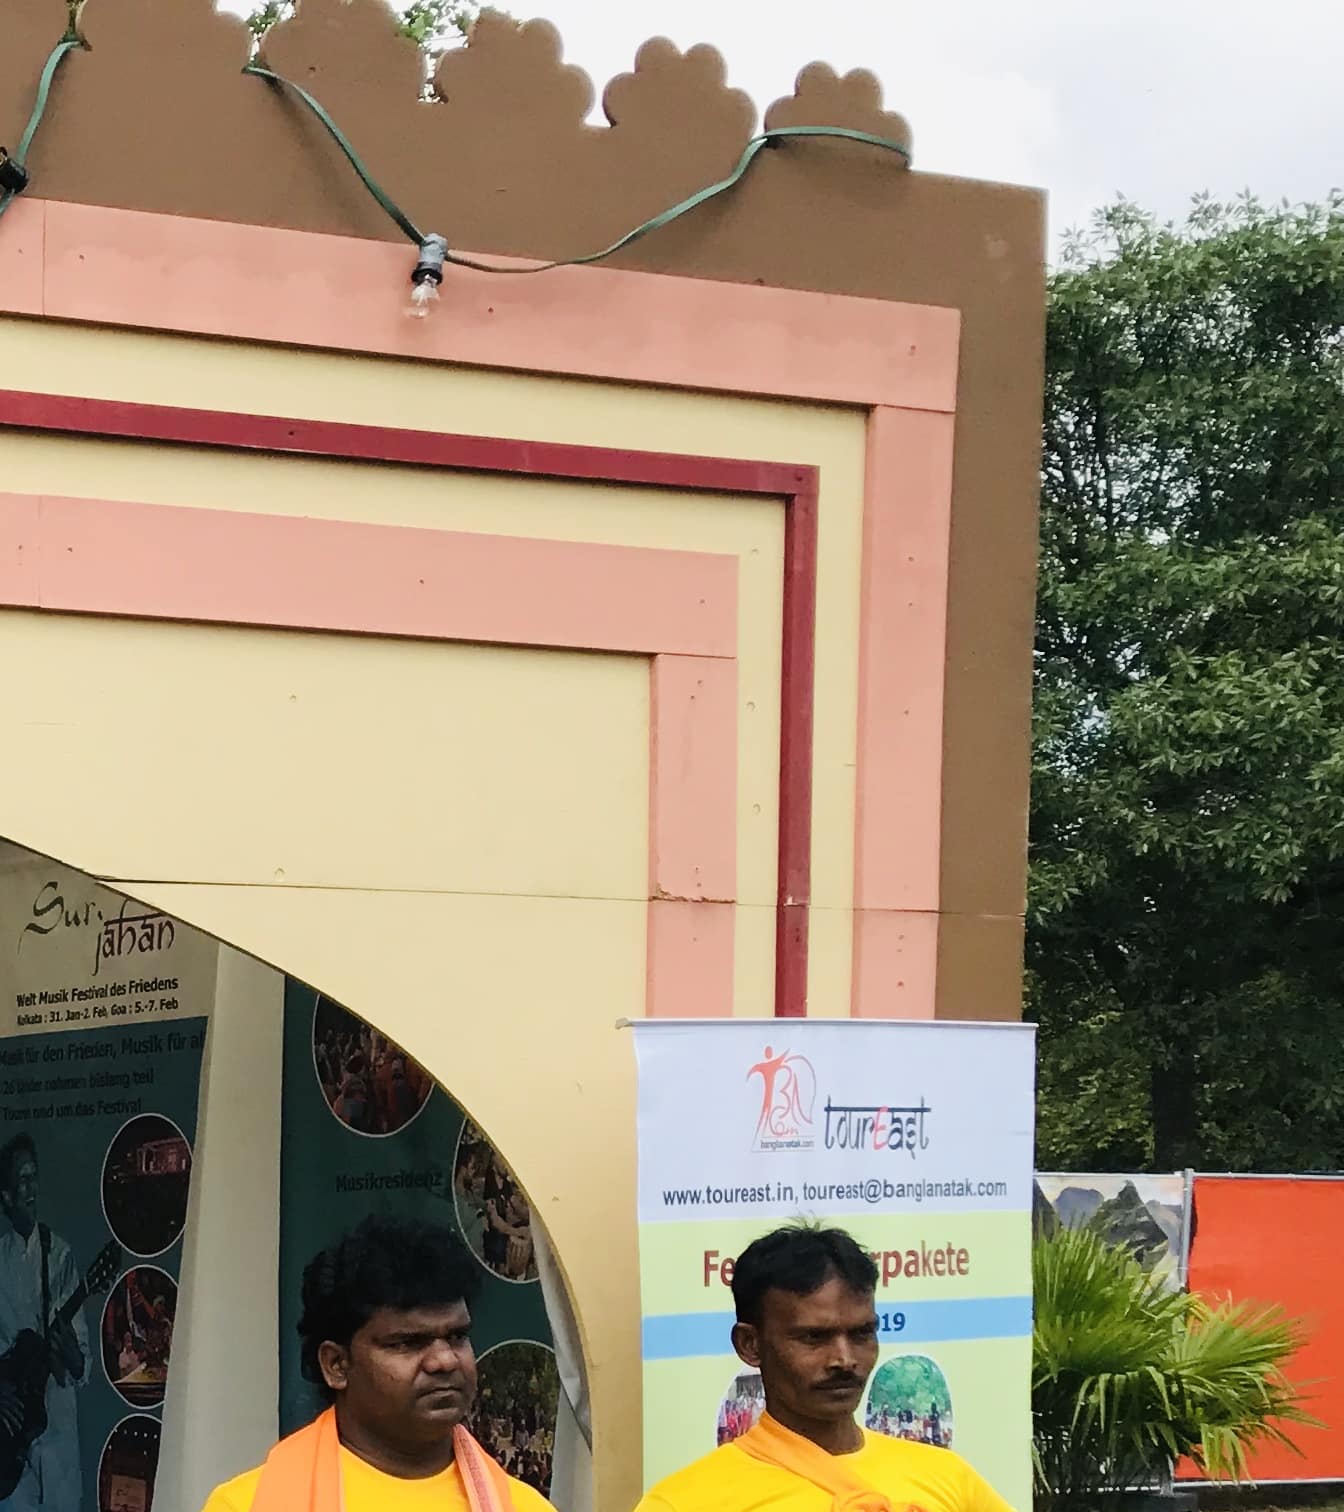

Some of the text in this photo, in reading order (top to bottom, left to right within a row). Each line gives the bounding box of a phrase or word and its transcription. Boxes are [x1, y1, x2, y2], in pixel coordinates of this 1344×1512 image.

[17, 977, 178, 1007] Welt Musik Festival des Friedens
[49, 1011, 63, 1022] 31.
[111, 1005, 126, 1016] Goa
[160, 997, 178, 1010] Feb
[43, 1046, 63, 1061] den
[121, 1034, 162, 1055] Musik
[167, 1032, 186, 1050] für
[56, 1105, 73, 1117] um
[76, 1101, 95, 1116] das
[97, 1098, 142, 1115] Festival
[824, 1096, 931, 1159] tourEast
[663, 1178, 1007, 1206] www.toureast.in, toureast@banglanatak.com
